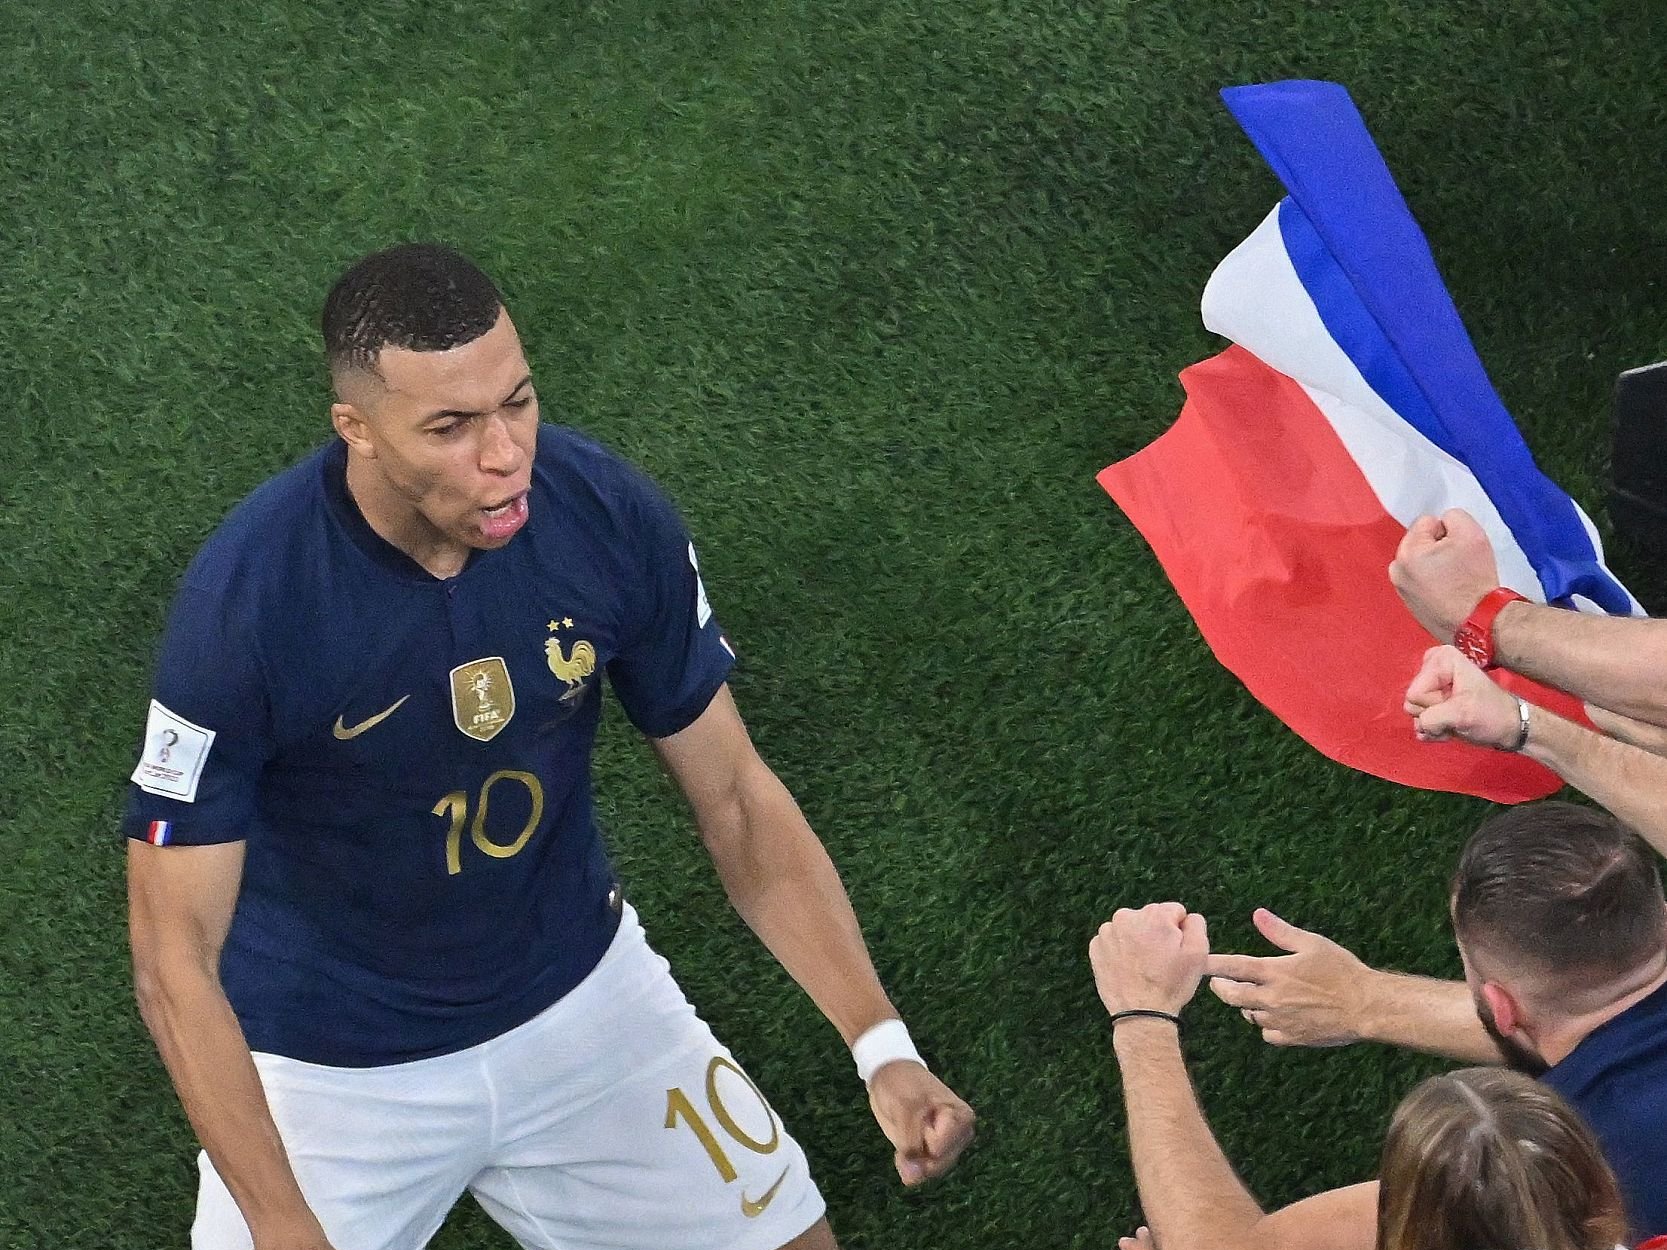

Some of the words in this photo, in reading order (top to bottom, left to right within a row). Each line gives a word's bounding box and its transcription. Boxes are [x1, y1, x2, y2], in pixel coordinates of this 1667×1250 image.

[473, 710, 498, 724] FIFA
[431, 769, 544, 875] 10
[664, 1056, 778, 1183] 10
